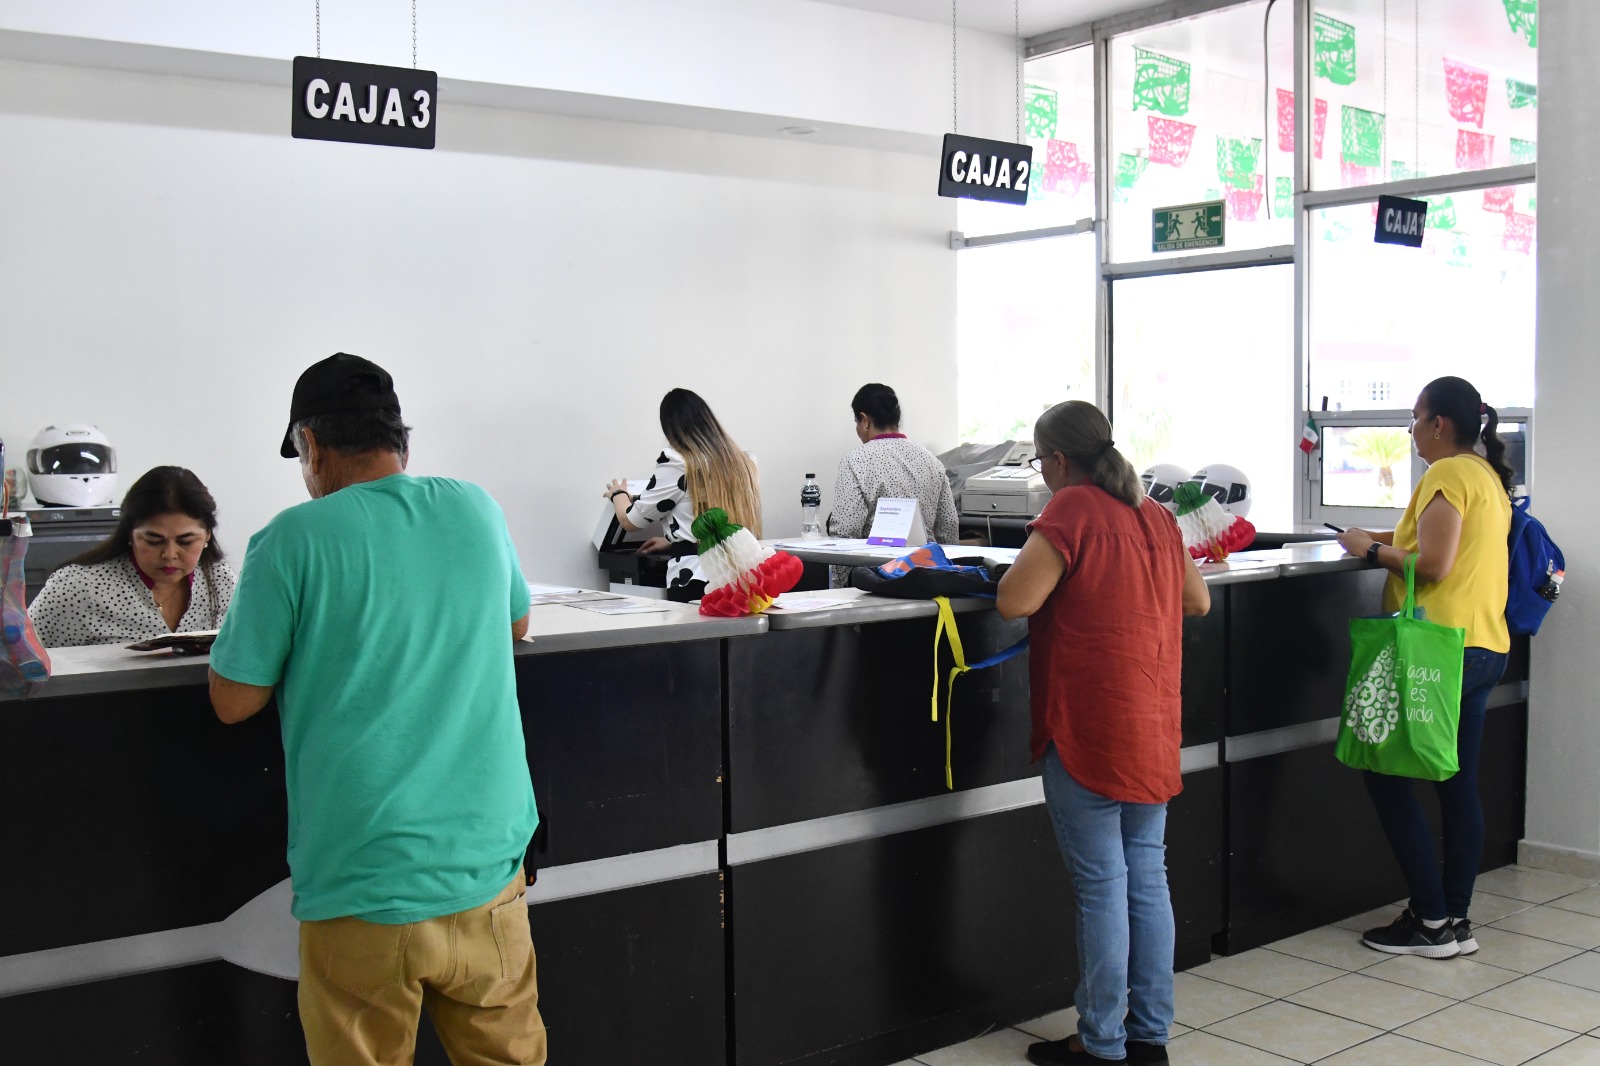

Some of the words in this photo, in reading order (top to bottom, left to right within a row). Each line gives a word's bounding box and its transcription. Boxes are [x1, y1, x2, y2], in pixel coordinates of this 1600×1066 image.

[306, 78, 405, 127] CAJA
[411, 89, 431, 129] 3
[951, 150, 1011, 189] CAJA
[1014, 160, 1029, 191] 2
[1384, 207, 1418, 236] CAJA
[1158, 242, 1175, 250] SALIDA
[1176, 241, 1184, 249] DE
[1185, 239, 1218, 248] EMERGENCIA
[1407, 665, 1441, 685] agua
[1410, 687, 1427, 703] es
[1405, 704, 1434, 723] vida
